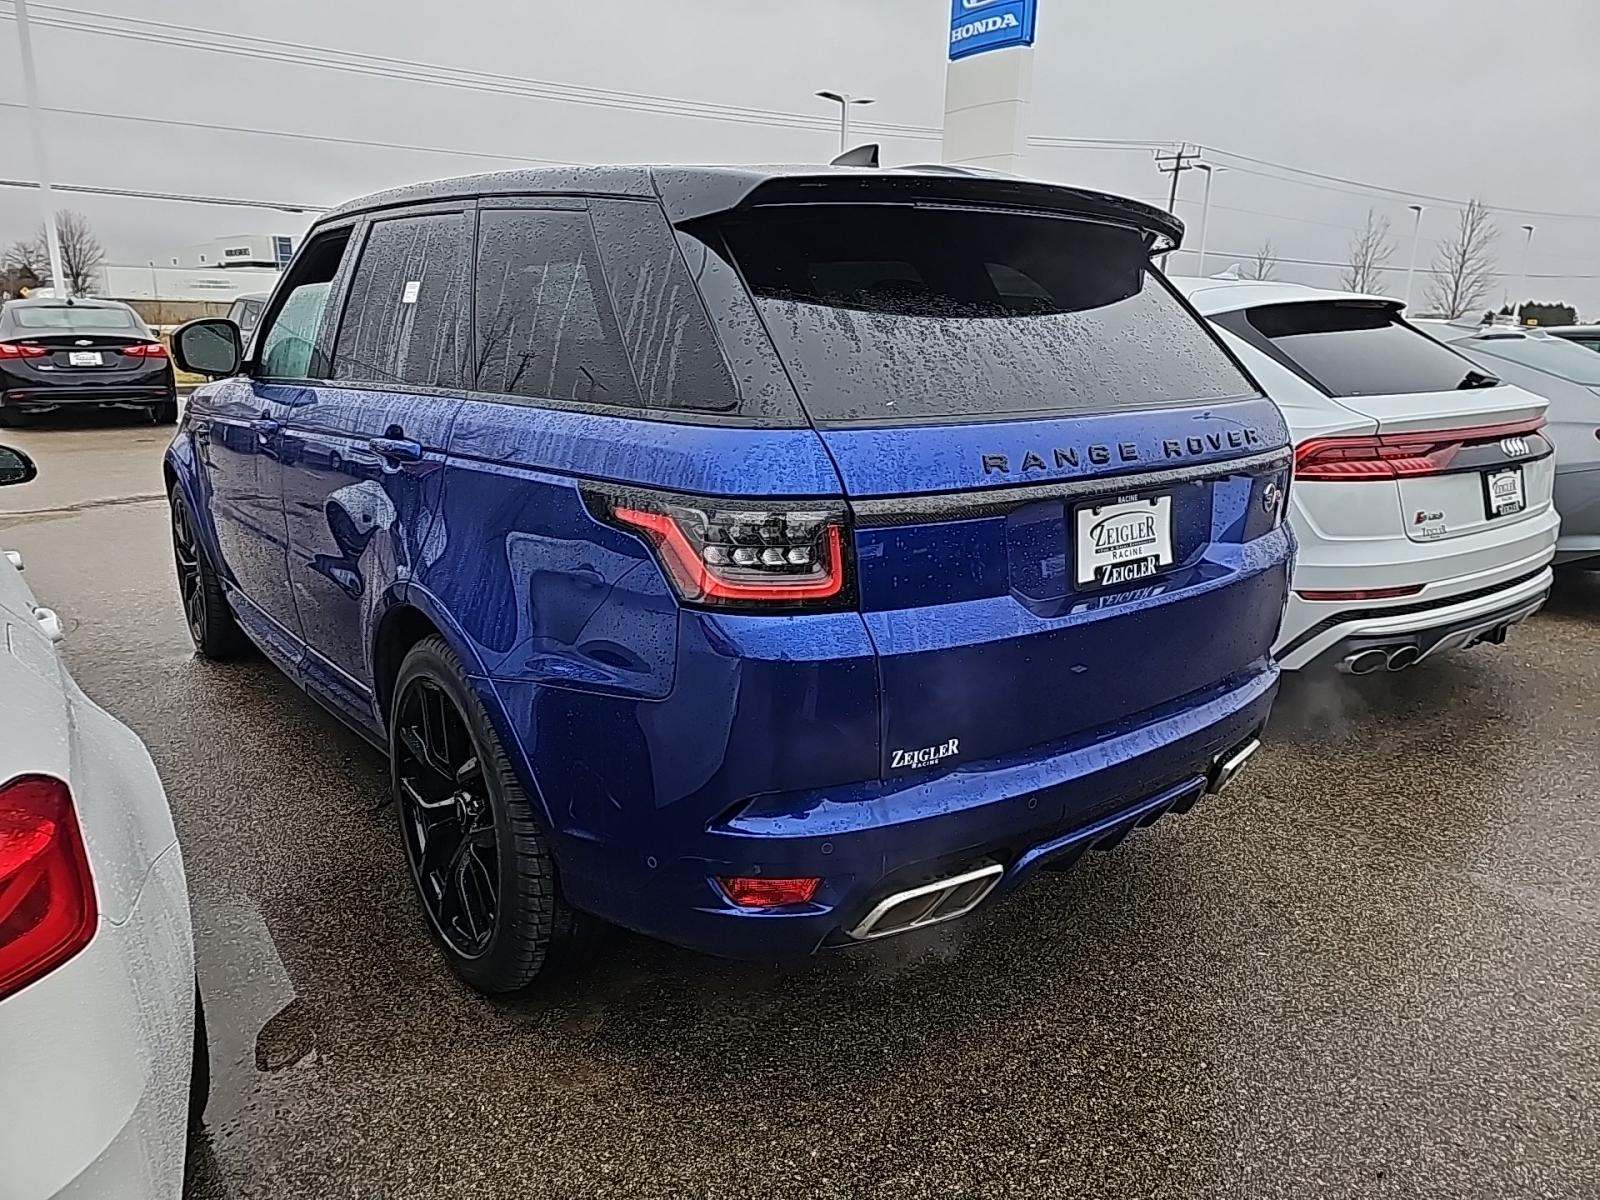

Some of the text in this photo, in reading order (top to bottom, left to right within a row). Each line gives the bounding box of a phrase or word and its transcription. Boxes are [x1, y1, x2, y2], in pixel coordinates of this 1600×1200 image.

[951, 13, 1019, 43] HONDA
[982, 429, 1259, 474] RANGE ROVER
[1117, 494, 1139, 503] RACINE
[1094, 516, 1156, 547] ZEIGLER
[1112, 547, 1143, 560] RACINE
[1101, 556, 1157, 586] ZEIGLER
[890, 738, 959, 769] ZEIGLER
